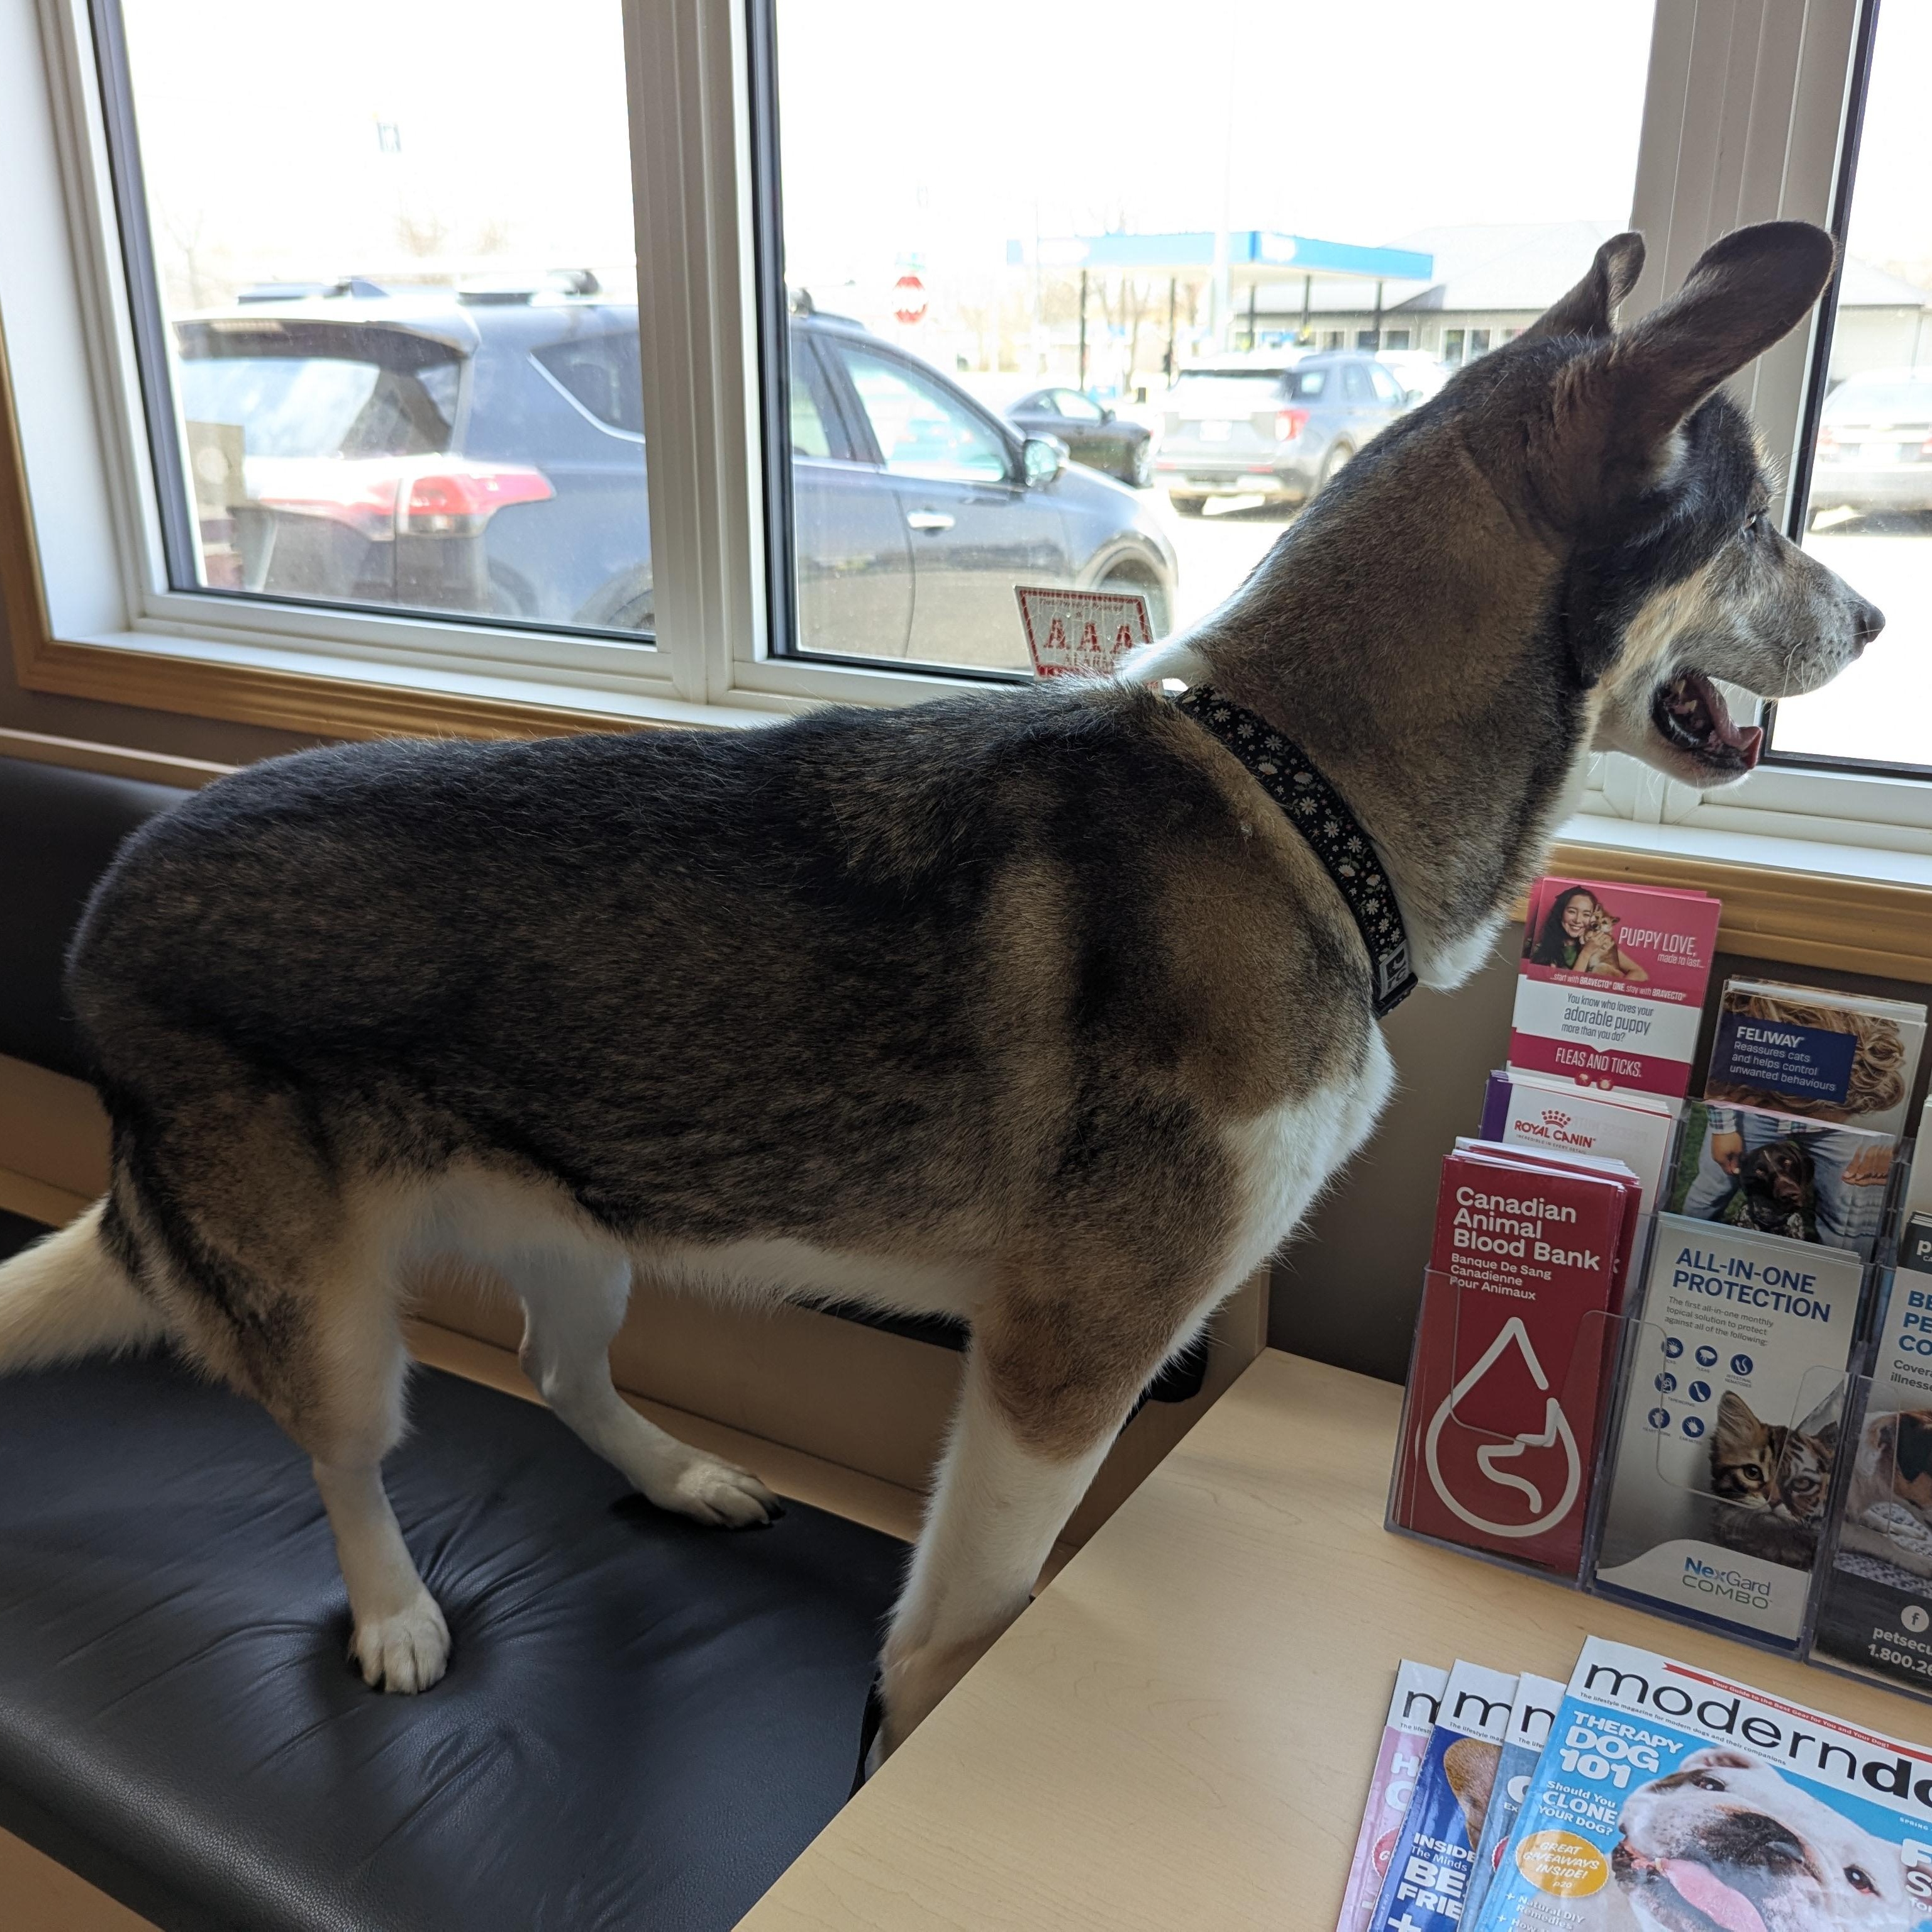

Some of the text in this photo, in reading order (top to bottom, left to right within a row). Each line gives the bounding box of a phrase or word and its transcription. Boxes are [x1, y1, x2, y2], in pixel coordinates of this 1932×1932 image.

[1619, 927, 1697, 956] PUPPY LOVE,
[1658, 953, 1677, 963] made
[1678, 956, 1685, 965] to
[1626, 985, 1638, 994] stay
[1639, 987, 1652, 996] with
[1567, 993, 1653, 1017] You know who loves your
[1561, 1024, 1625, 1041] more than you do?
[1564, 1006, 1652, 1035] adorable puppy
[1556, 1048, 1641, 1077] FLEAS AND TICKS.
[1732, 1054, 1817, 1075] and helps control
[1735, 1041, 1811, 1063] Reassures cats
[1729, 1065, 1836, 1091] unwanted behaviours
[1514, 1120, 1550, 1138] ROYAL
[1457, 1187, 1576, 1223] Canadian
[1453, 1208, 1541, 1239] Animal
[1454, 1228, 1525, 1257] Blood
[1534, 1242, 1601, 1271] Bank
[1450, 1265, 1523, 1285] Canadienne
[1452, 1253, 1552, 1280] Banque De Sang
[1676, 1248, 1816, 1294] ALL-IN-ONE
[1450, 1276, 1536, 1301] Pour Animaux
[1673, 1270, 1830, 1322] PROTECTION
[1667, 1306, 1692, 1318] topical
[1694, 1313, 1726, 1325] solution
[1737, 1323, 1767, 1336] protect
[1669, 1296, 1774, 1328] The first all-in-one monthly
[1664, 1317, 1692, 1328] against
[1715, 1328, 1728, 1336] the
[1729, 1331, 1768, 1346] following:
[1685, 1557, 1770, 1596] NexGard
[1682, 1575, 1768, 1609] COMBO
[1712, 1680, 1728, 1689] Your
[1729, 1685, 1750, 1697] Guide
[1761, 1697, 1773, 1706] the
[1774, 1701, 1790, 1712] Best
[1792, 1708, 1809, 1719] Gear
[1823, 1719, 1836, 1729] You
[1838, 1726, 1852, 1735] and
[1853, 1730, 1869, 1741] Your
[1871, 1738, 1889, 1748] Dog!
[1463, 1724, 1488, 1738] lifestyle
[1574, 1711, 1684, 1753] THERAPY
[1593, 1696, 1619, 1707] lifestyle
[1621, 1703, 1653, 1717] magazine
[1665, 1718, 1691, 1729] modern
[1692, 1727, 1709, 1738] dogs
[1711, 1735, 1724, 1743] and
[1726, 1737, 1743, 1748] their
[1744, 1746, 1786, 1765] companions
[1565, 1725, 1659, 1774] DOG
[1560, 1748, 1631, 1788] 101
[1542, 1790, 1618, 1825] CLONE
[1547, 1780, 1591, 1799] Should
[1594, 1794, 1616, 1808] You
[1538, 1806, 1613, 1835] YOUR DOG?
[1899, 1817, 1928, 1830] SPRING
[1411, 1845, 1467, 1872] The Minds
[1523, 1851, 1599, 1870] GIVEAWAYS
[1540, 1842, 1582, 1855] GREAT
[1535, 1863, 1589, 1879] INSIDE!
[1516, 1904, 1572, 1930] Remedies
[1518, 1896, 1585, 1924] Natural DIY
[1511, 1918, 1535, 1931] How
